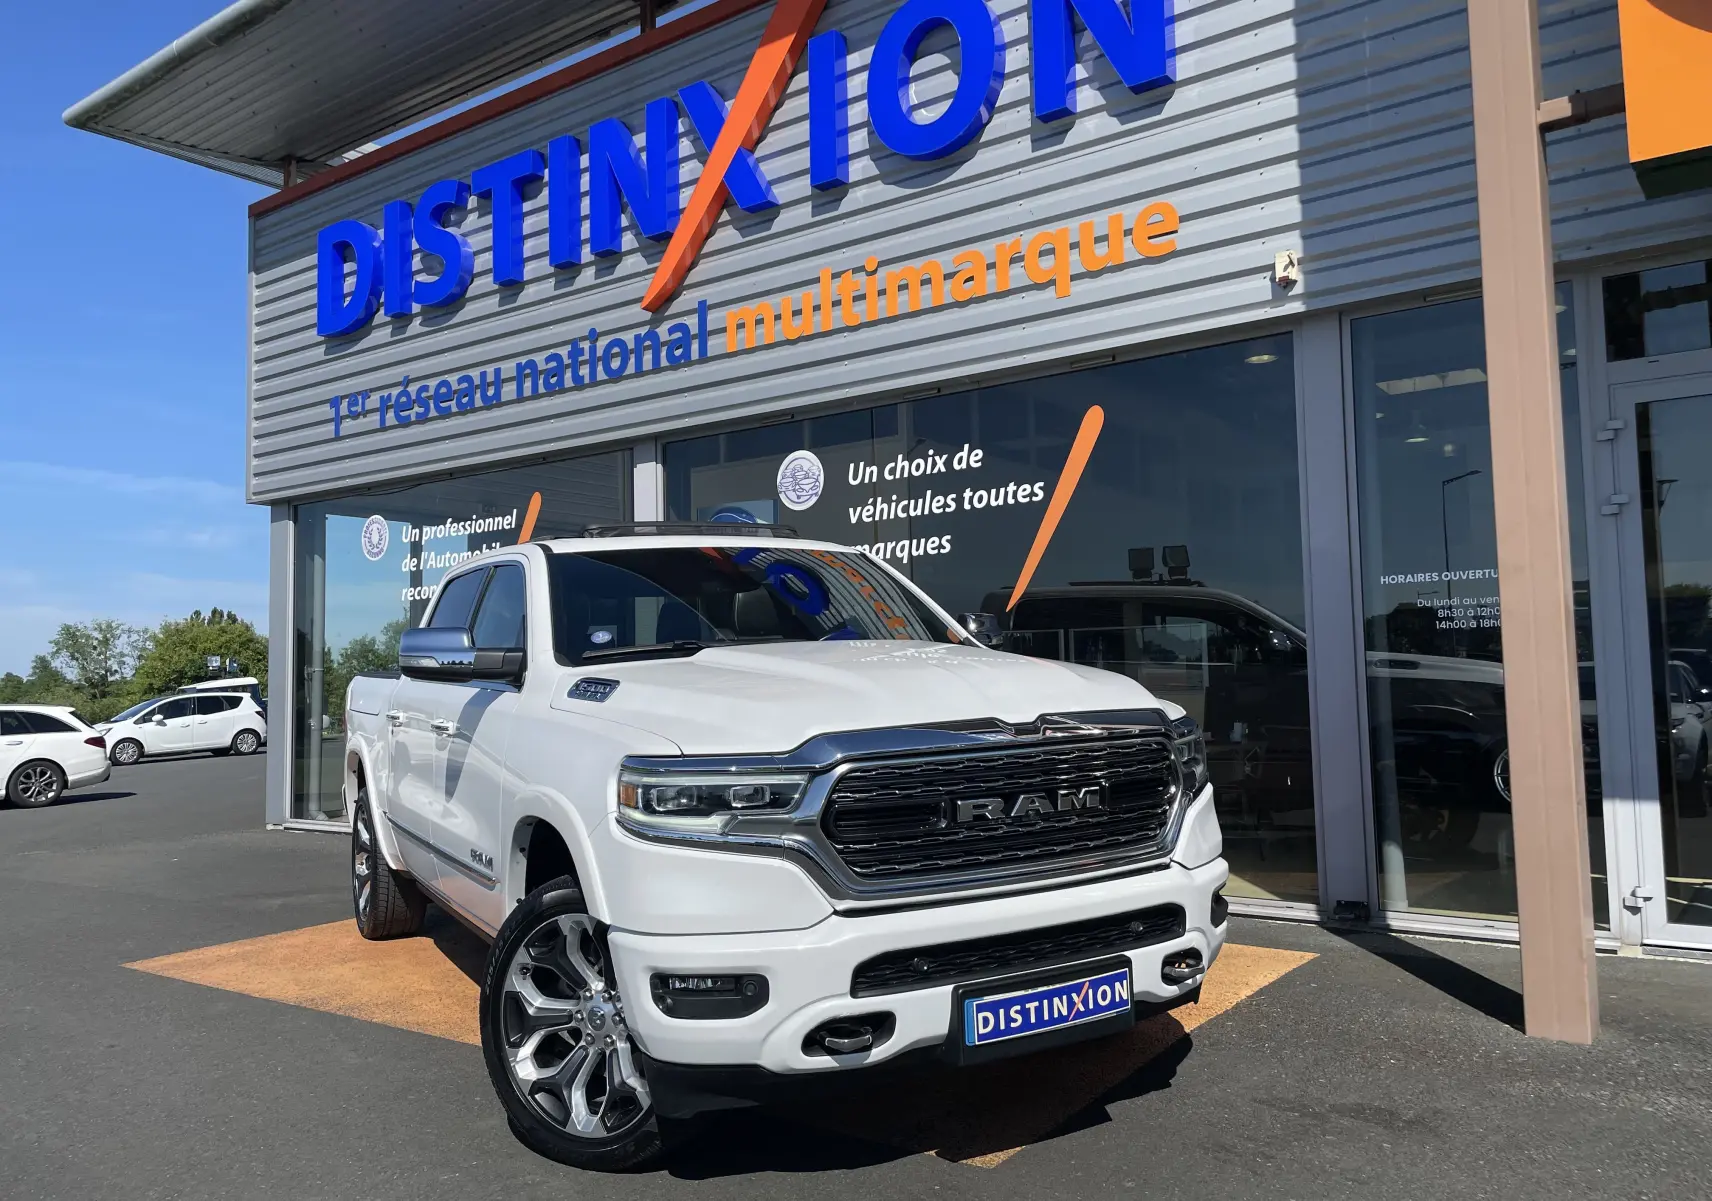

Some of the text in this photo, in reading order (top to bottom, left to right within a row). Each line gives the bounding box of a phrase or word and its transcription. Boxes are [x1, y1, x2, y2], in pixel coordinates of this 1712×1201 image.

[317, 0, 1177, 337] DISTINXION
[329, 201, 1180, 438] 1er réseau national multimarque
[848, 443, 983, 486] Un choix de
[848, 480, 1045, 524] véhicules toutes
[401, 525, 420, 543] Un
[421, 508, 518, 546] professionnel
[401, 556, 417, 572] de
[1380, 572, 1439, 585] HORAIRES
[1417, 599, 1431, 607] Du
[1433, 596, 1460, 607] lundi
[1462, 597, 1477, 605] au
[1437, 608, 1464, 618] 8h30
[1467, 606, 1474, 617] à
[1436, 620, 1467, 630] 14h00
[1469, 618, 1477, 628] à
[957, 786, 1100, 823] RAM
[977, 979, 1129, 1035] DISTINXION
